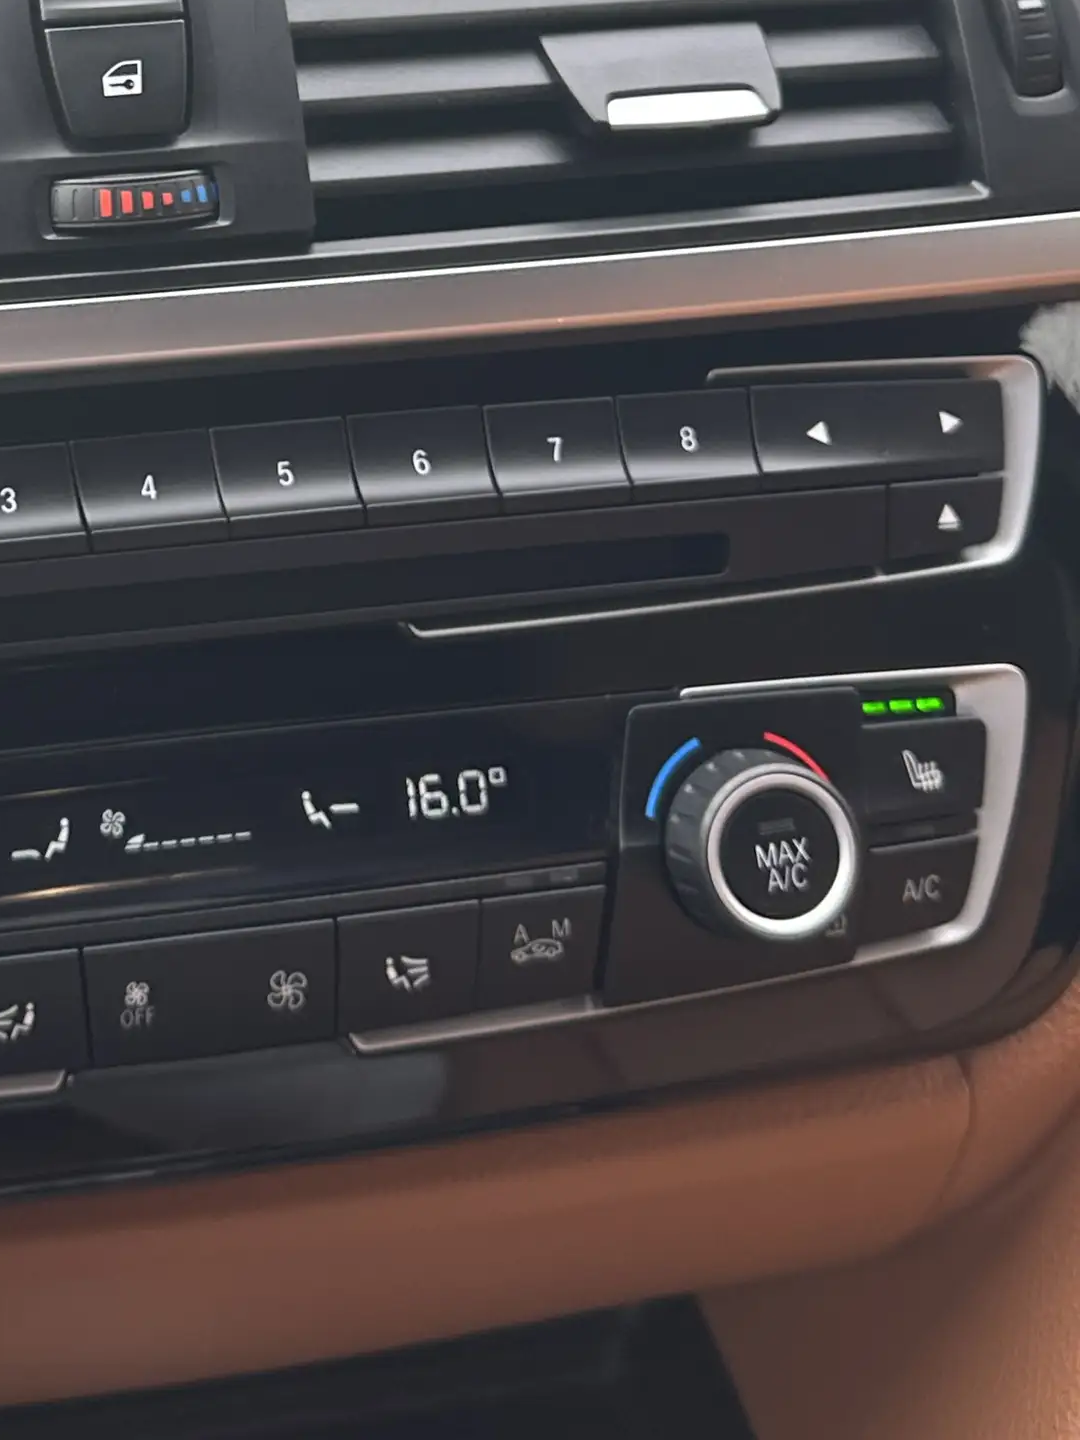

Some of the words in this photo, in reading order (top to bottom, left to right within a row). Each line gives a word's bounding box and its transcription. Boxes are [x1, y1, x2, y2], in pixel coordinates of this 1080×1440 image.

[546, 436, 562, 462] 7
[679, 425, 699, 453] 8
[276, 460, 294, 487] 5
[411, 448, 431, 476] 6
[0, 486, 18, 513] 3
[140, 474, 157, 500] 4
[754, 836, 813, 870] MAX
[768, 862, 809, 893] A/C
[902, 874, 942, 903] A/C
[513, 923, 530, 945] A
[551, 917, 571, 940] M
[120, 1006, 155, 1029] OFF
